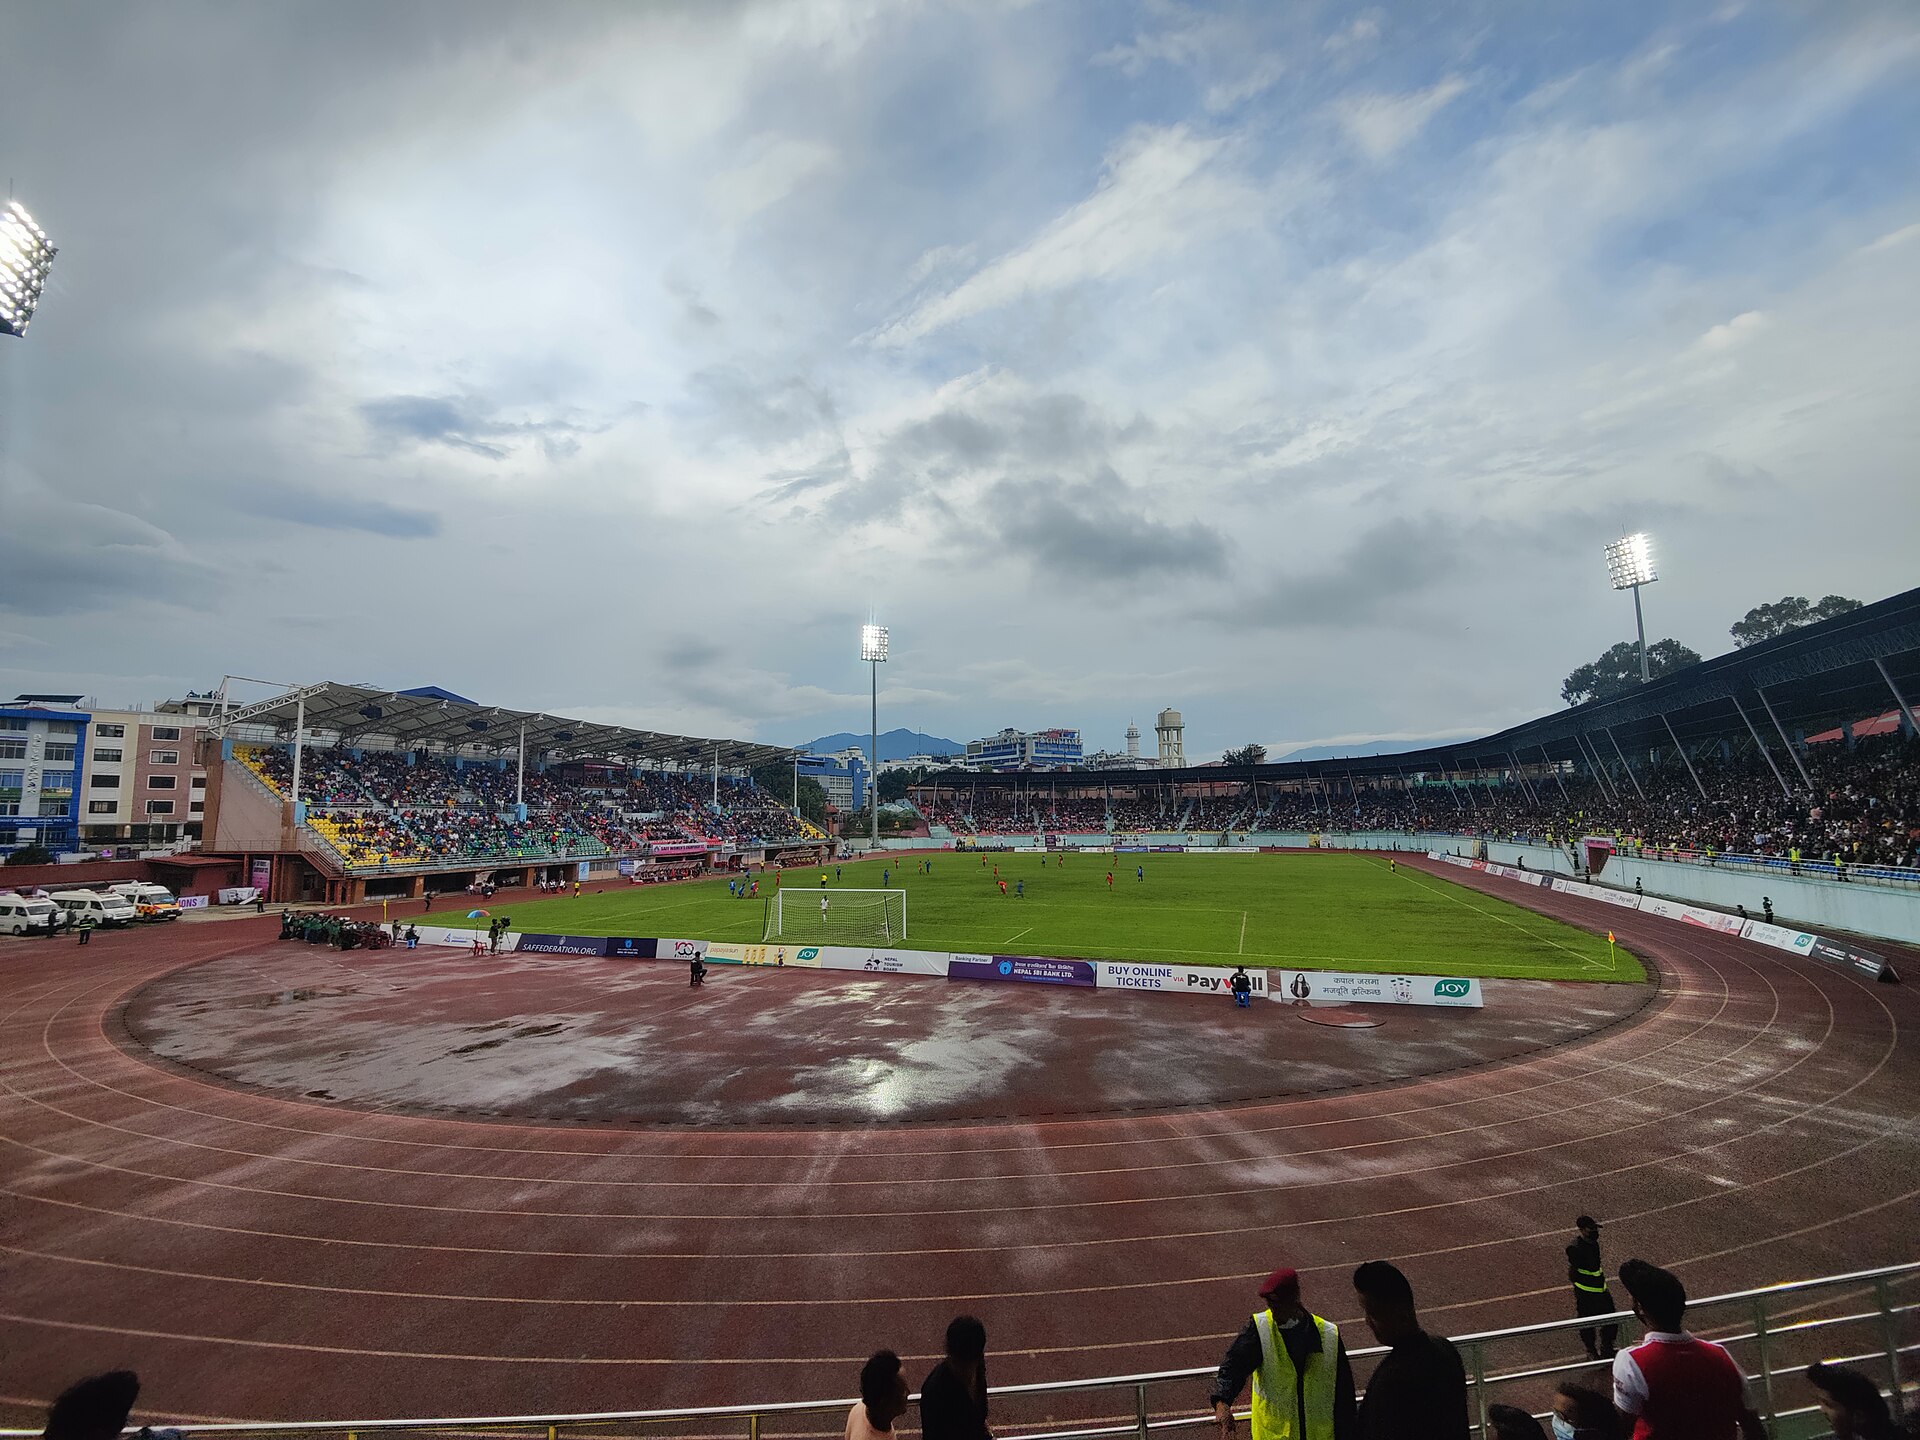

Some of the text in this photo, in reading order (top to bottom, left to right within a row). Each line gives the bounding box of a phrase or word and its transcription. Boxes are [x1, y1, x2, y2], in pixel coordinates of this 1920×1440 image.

[522, 943, 598, 956] SAFFEDERATION.ORG
[799, 950, 816, 958] JOY
[955, 955, 971, 963] Banking
[1108, 966, 1172, 977] BUY ONLINE
[1116, 977, 1161, 988] TICKETS
[1333, 977, 1354, 985] कपाल
[1437, 983, 1467, 993] JOY
